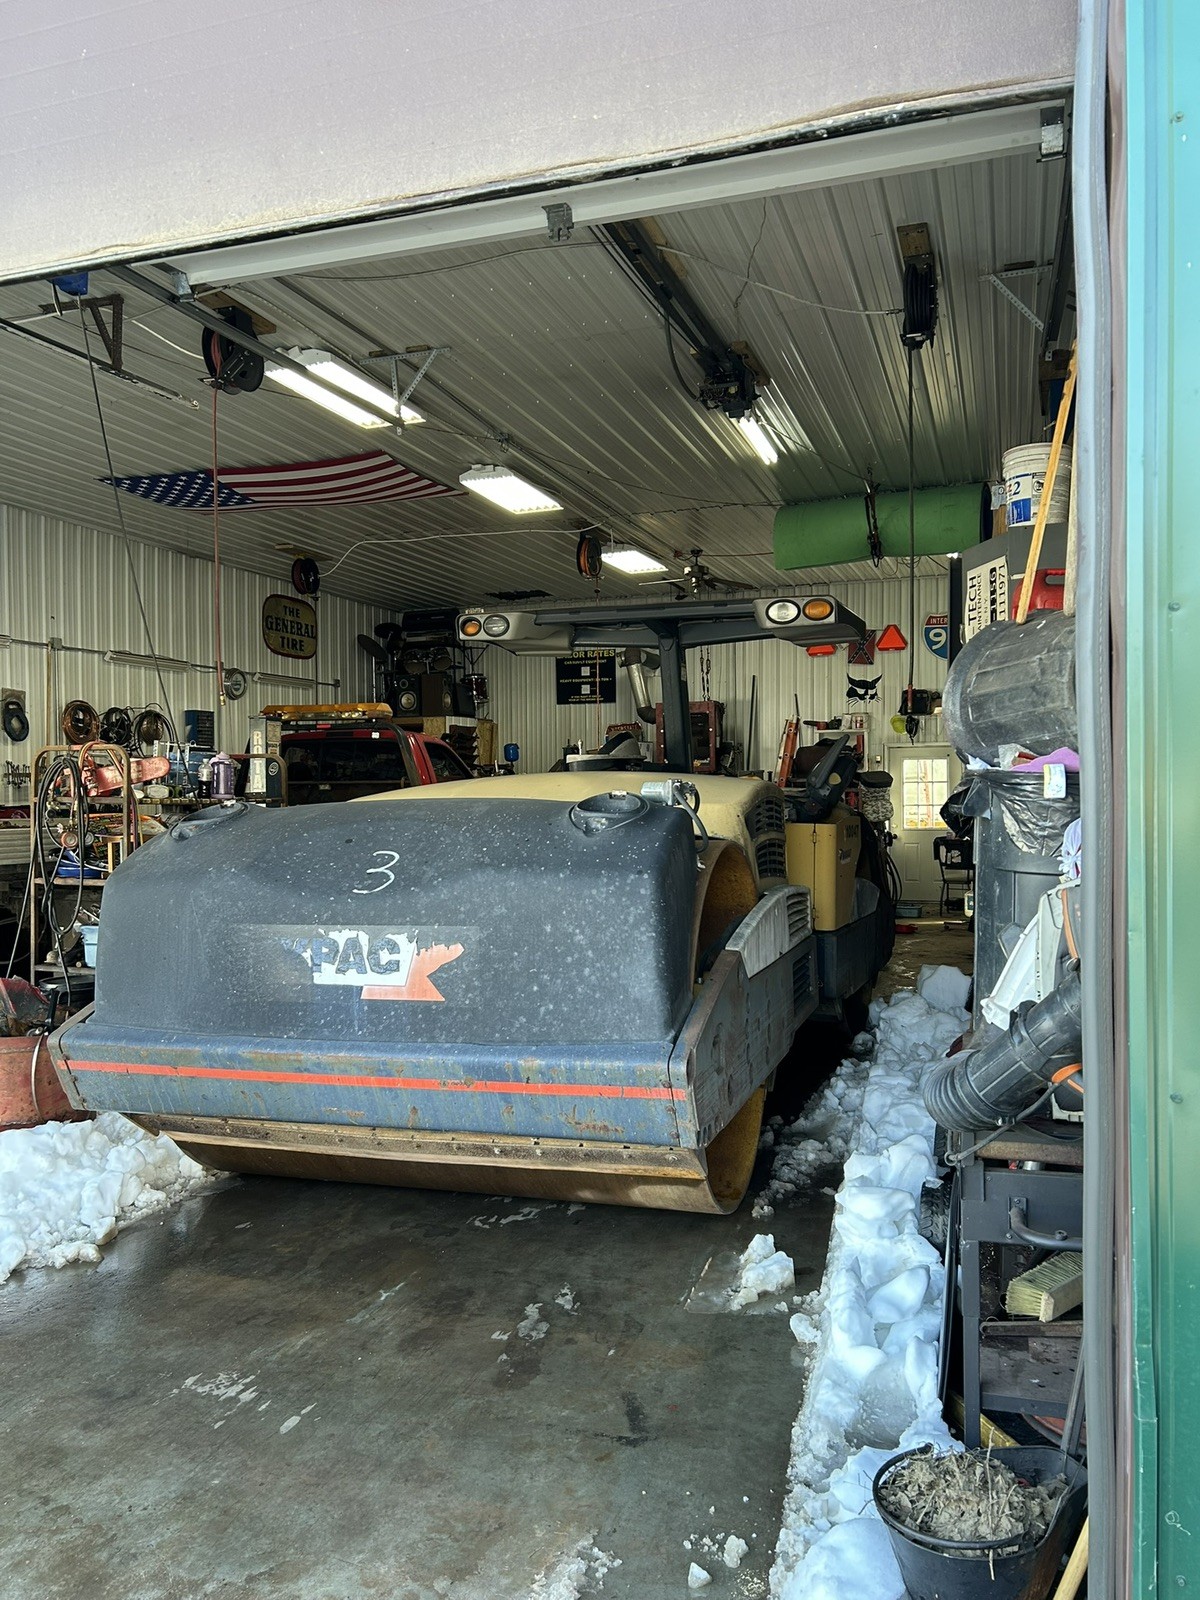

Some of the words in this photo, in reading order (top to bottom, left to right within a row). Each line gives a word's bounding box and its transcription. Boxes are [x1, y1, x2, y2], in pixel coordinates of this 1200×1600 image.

[283, 605, 301, 618] THE
[265, 615, 317, 639] GENERAL
[280, 636, 305, 652] TIRE
[587, 649, 615, 658] RATES
[352, 850, 400, 894] 3
